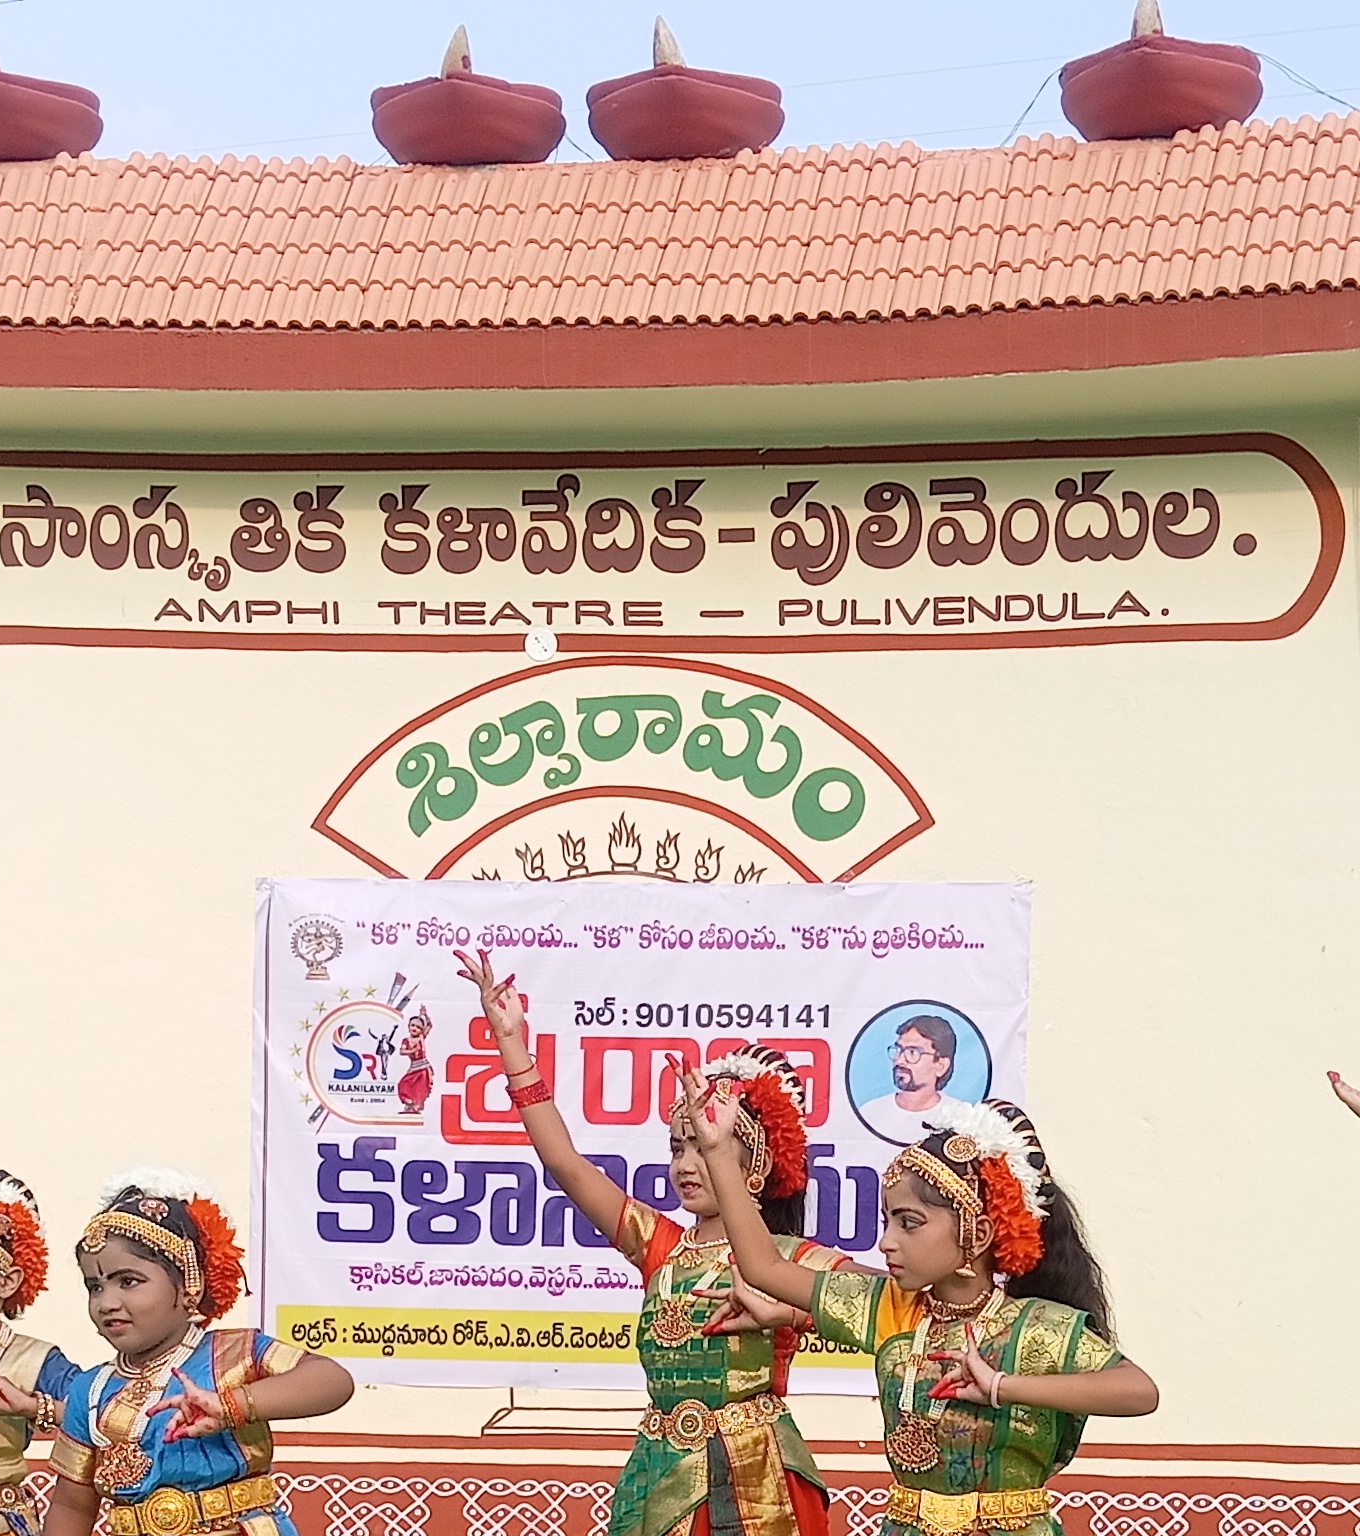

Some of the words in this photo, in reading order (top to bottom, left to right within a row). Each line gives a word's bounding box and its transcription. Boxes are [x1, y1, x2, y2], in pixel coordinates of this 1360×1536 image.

[154, 598, 340, 625] AMPHI
[377, 600, 664, 626] THEATRE
[778, 590, 1170, 627] PULIVENDULA.
[395, 690, 866, 842] శిల్పారామం
[416, 916, 471, 947] కోసం
[639, 920, 693, 950] కోసం
[636, 1003, 831, 1029] 9010594141
[328, 1083, 395, 1093] KALANILAYAM
[351, 1321, 449, 1357] ముద్దనూరు
